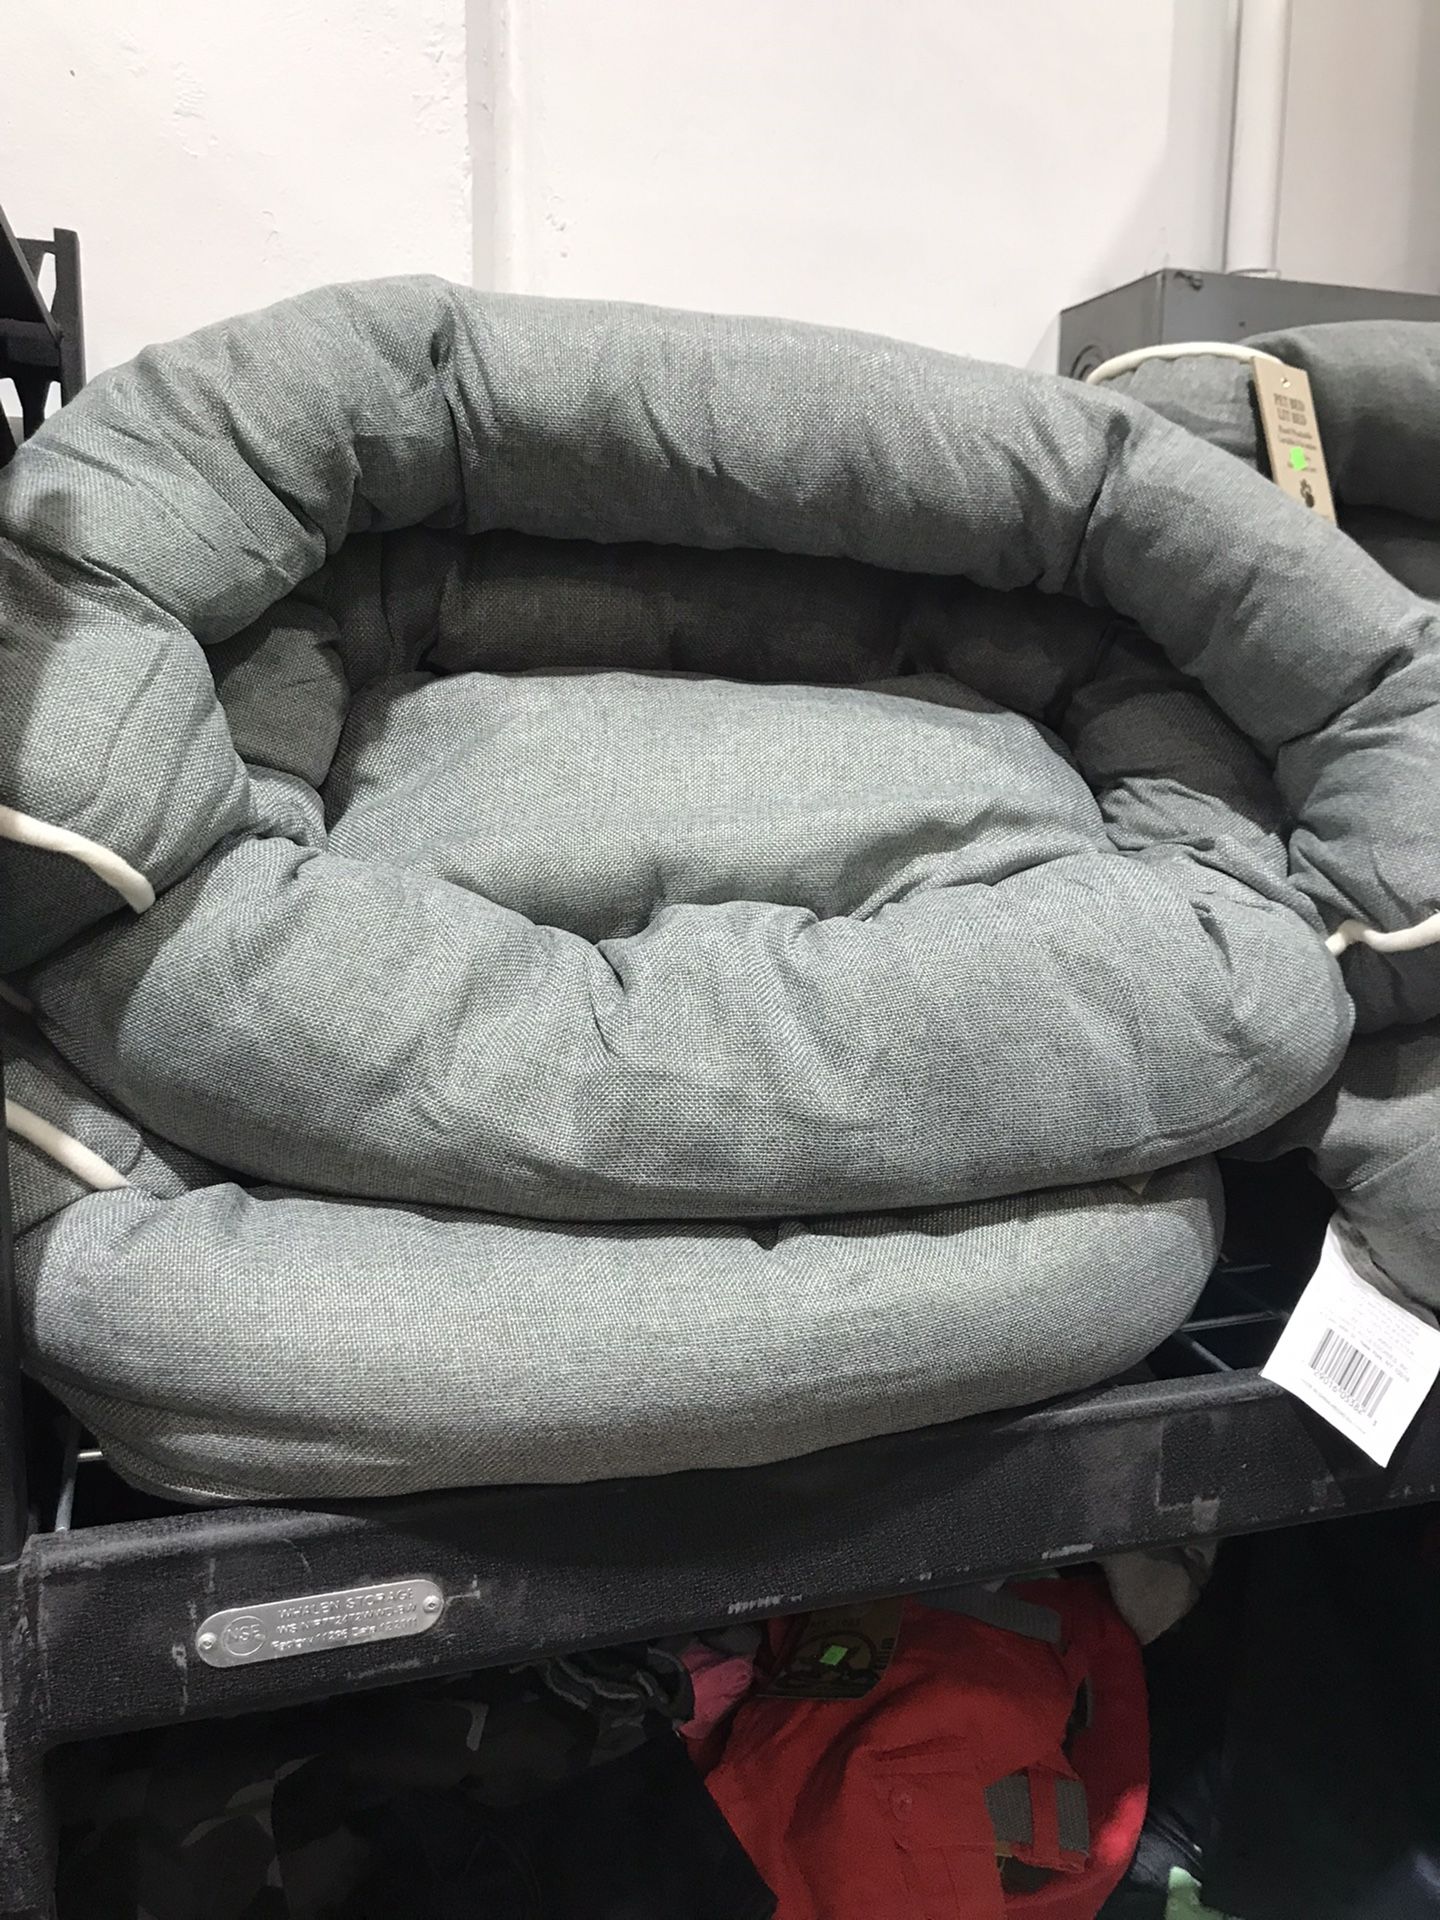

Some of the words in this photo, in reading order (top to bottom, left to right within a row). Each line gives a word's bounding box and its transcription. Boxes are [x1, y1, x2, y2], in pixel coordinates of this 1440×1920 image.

[1274, 393, 1289, 407] PET
[1290, 398, 1305, 411] BED
[1292, 412, 1307, 425] BED
[278, 1600, 340, 1619] WHALEN
[345, 1587, 414, 1609] STORAGE
